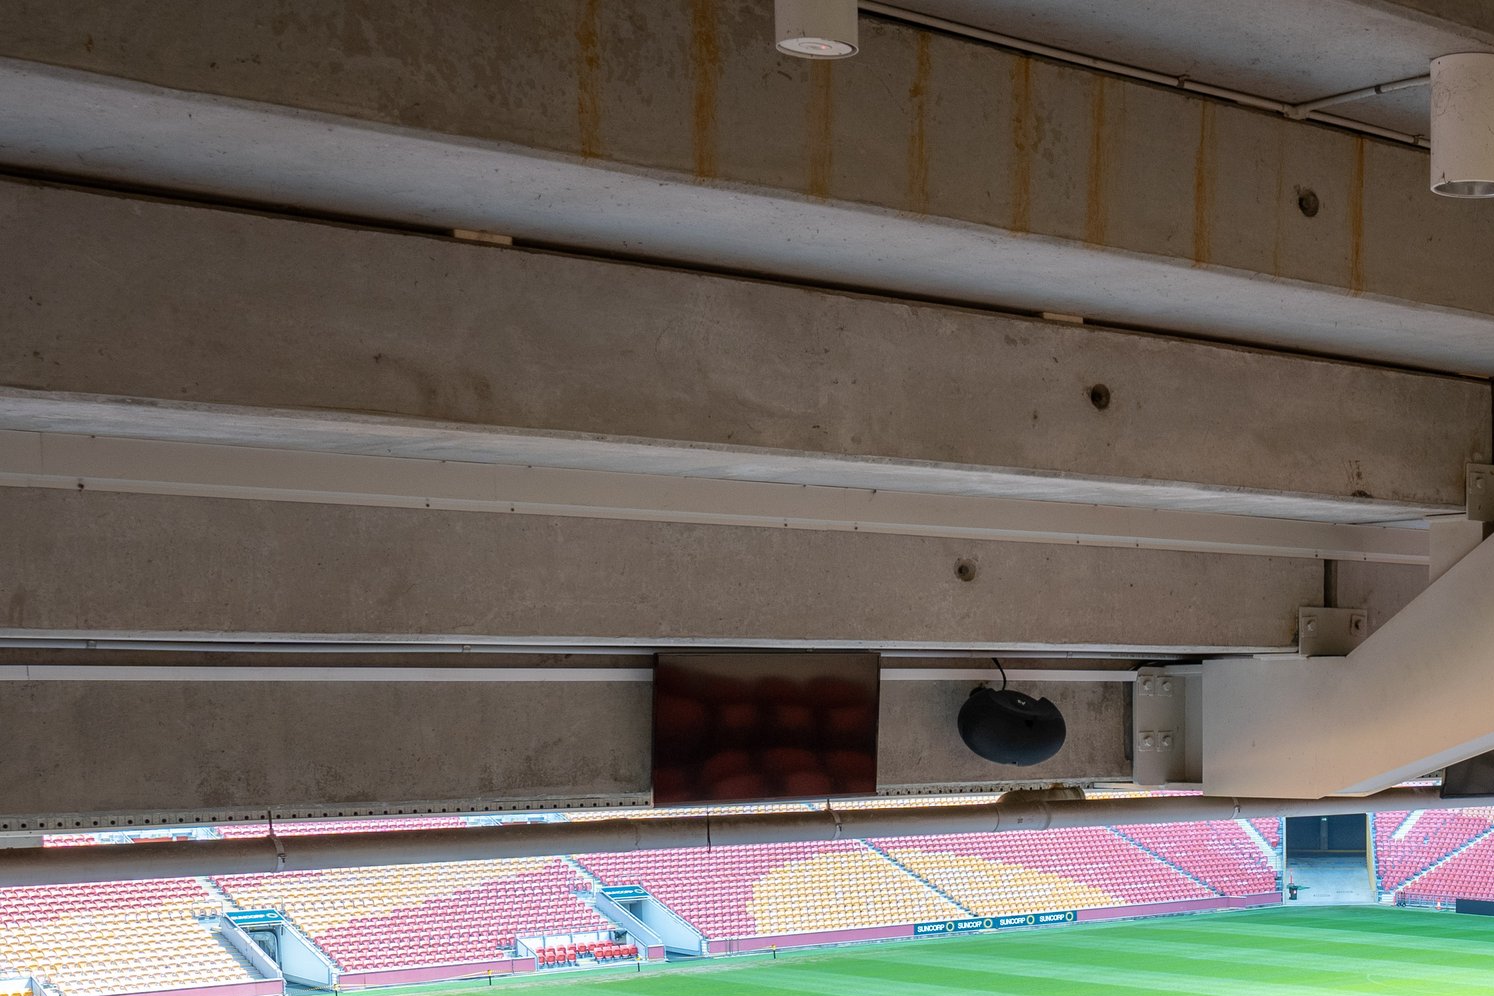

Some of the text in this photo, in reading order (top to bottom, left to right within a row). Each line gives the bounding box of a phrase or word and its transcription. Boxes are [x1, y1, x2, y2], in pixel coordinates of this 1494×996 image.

[999, 917, 1026, 926] SUNCORP
[1039, 914, 1065, 923] SUNCORP
[917, 924, 945, 933] SUNCORP
[957, 920, 983, 929] SUNCORP
